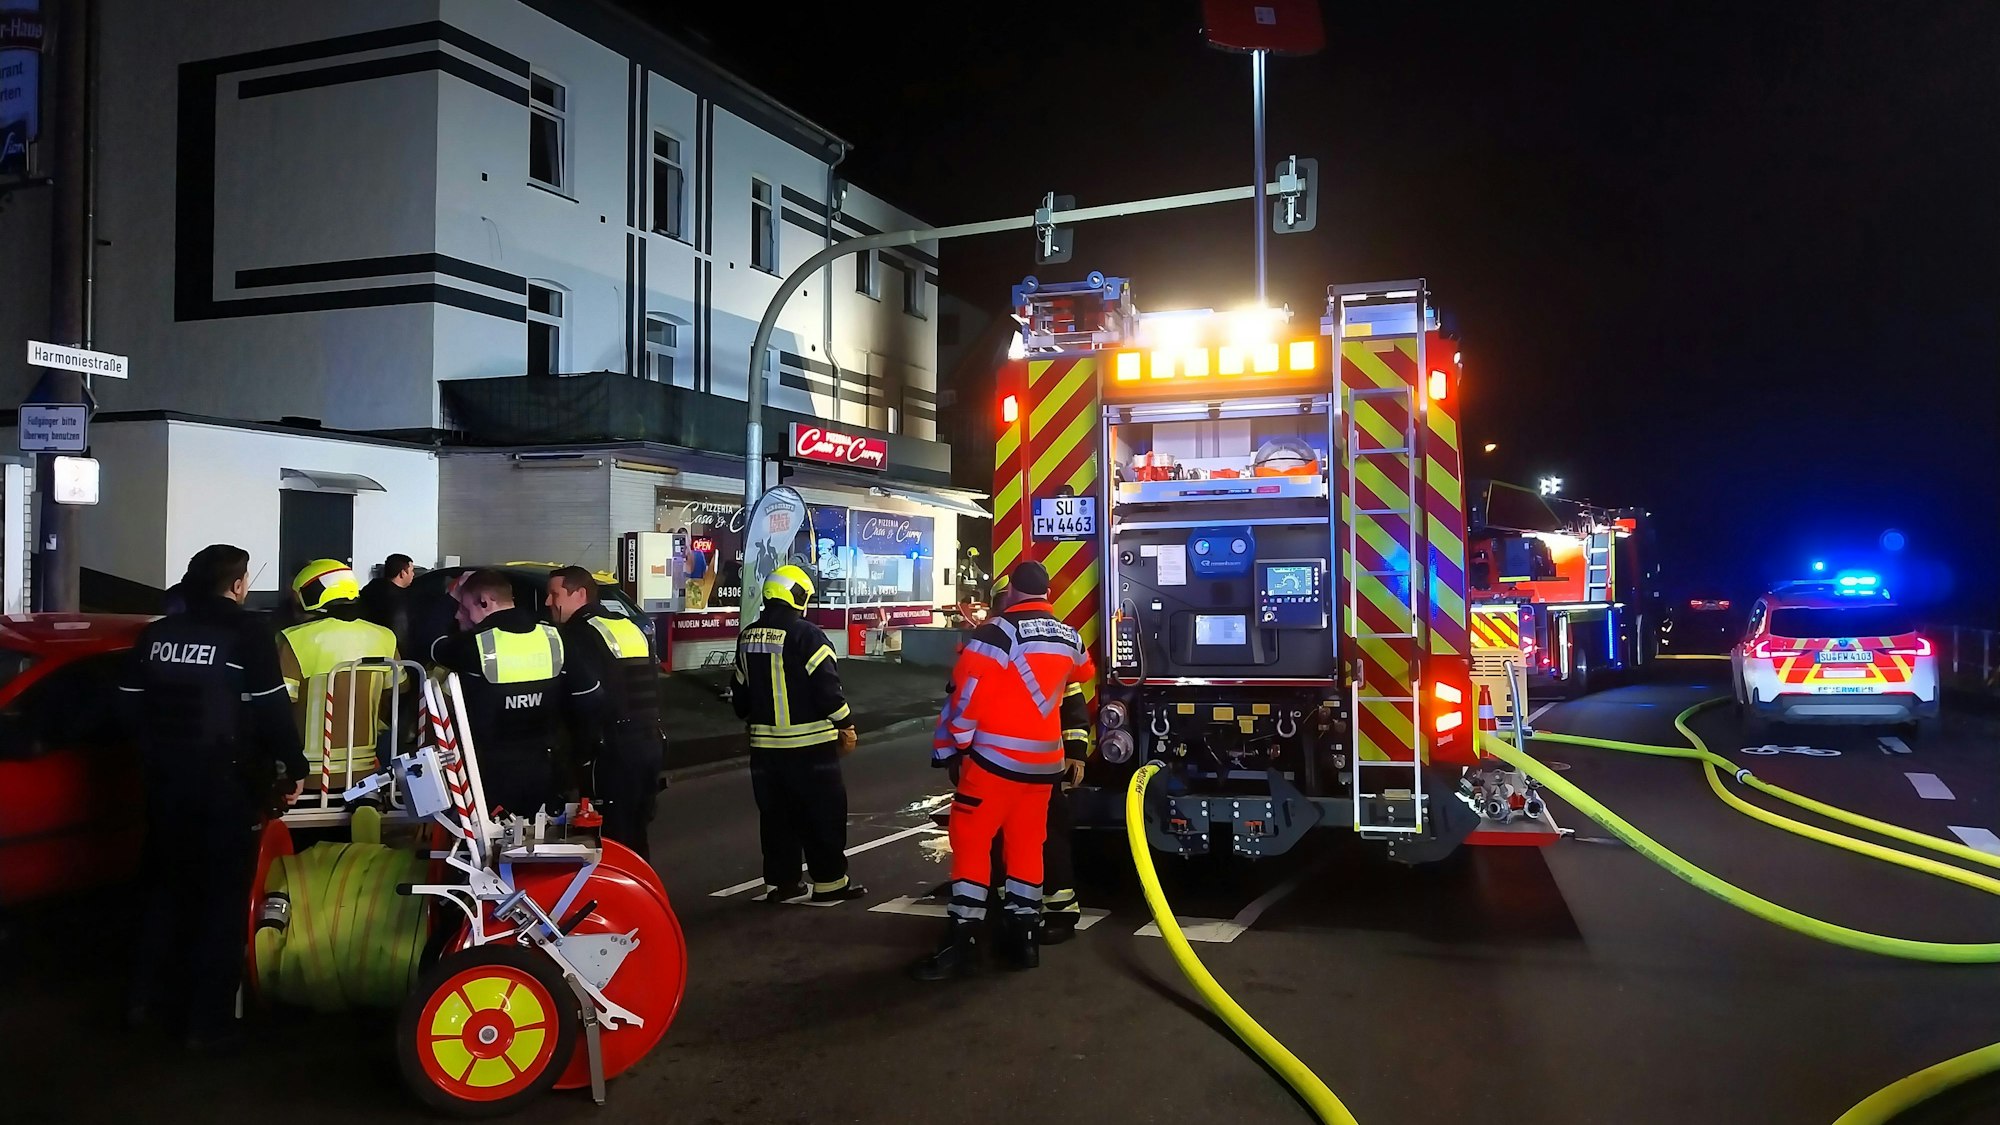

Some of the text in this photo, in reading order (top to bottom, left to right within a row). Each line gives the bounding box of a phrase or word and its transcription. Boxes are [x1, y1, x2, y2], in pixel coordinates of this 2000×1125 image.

[34, 345, 122, 373] Harmoniestraße
[27, 415, 77, 428] Fußgänger bitte
[51, 430, 80, 441] benutzen
[846, 437, 884, 467] Curry
[680, 501, 714, 526] Casa
[701, 501, 733, 515] PIZZERIA
[1056, 500, 1073, 516] SU
[862, 517, 886, 541] Casa
[896, 520, 922, 545] Curry
[878, 518, 899, 528] PIZZERIA
[1037, 516, 1092, 533] FW 4463
[692, 540, 712, 551] OPEN
[677, 619, 701, 629] NUDELN
[701, 618, 720, 628] SALATE
[149, 641, 217, 665] POLIZEI
[1820, 652, 1872, 661] SU FW 4103
[504, 692, 543, 710] NRW
